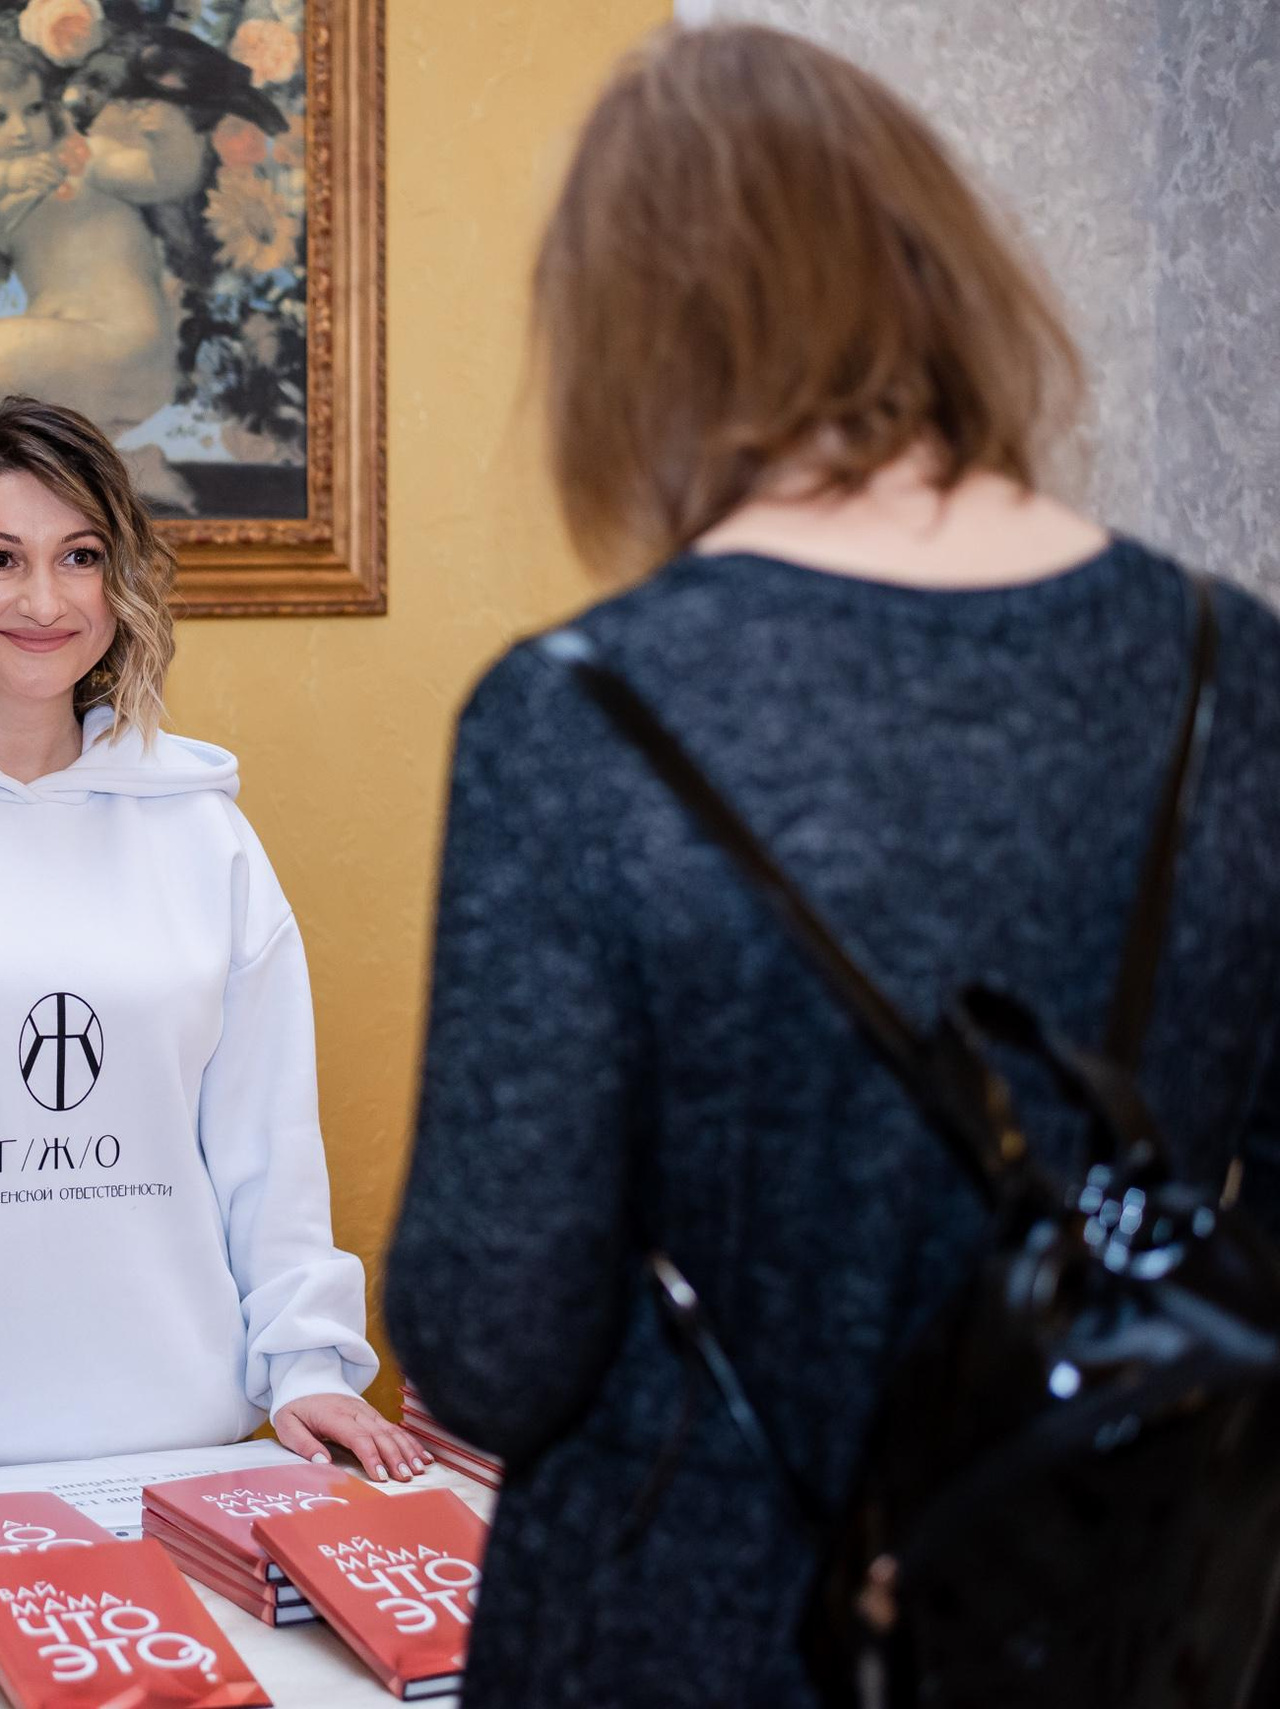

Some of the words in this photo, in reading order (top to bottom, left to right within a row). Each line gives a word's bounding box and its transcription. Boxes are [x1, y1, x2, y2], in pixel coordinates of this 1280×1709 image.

[59, 1183, 173, 1201] ОТВЕТСТВЕННОСТИ
[216, 1490, 323, 1510] МАМА,
[318, 1535, 383, 1558] ВАЙ,
[334, 1544, 449, 1573] МАМА,
[346, 1557, 482, 1597] ЧТО
[10, 1591, 132, 1618] МАМА,
[17, 1606, 161, 1644] ЧТО
[38, 1632, 218, 1683] ЭТО?
